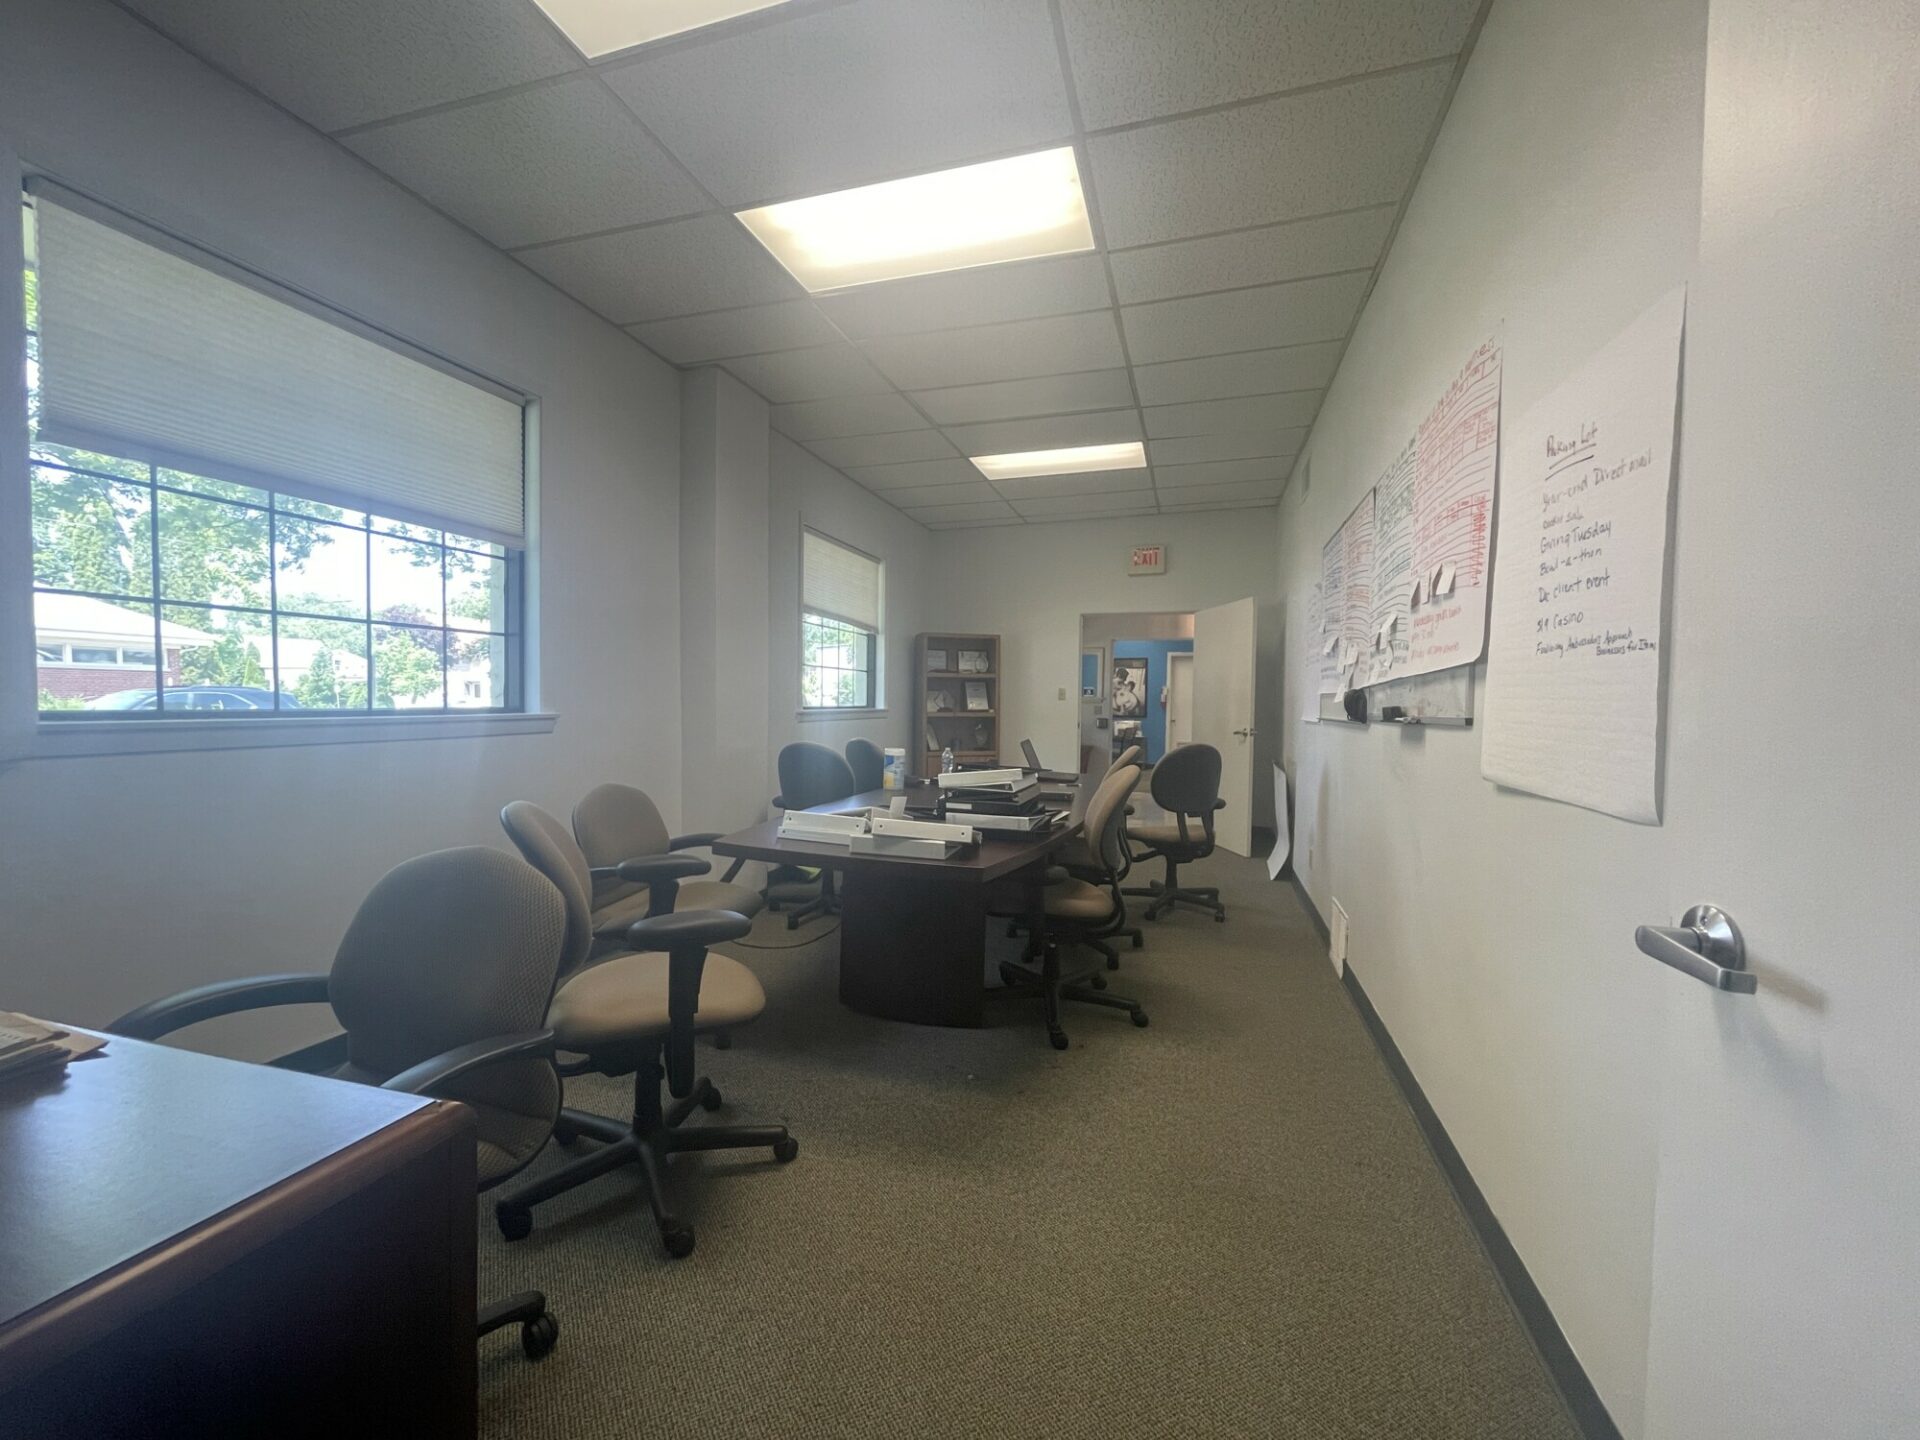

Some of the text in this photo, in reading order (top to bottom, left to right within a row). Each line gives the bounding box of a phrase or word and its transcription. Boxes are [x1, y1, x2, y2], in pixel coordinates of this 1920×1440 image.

[1581, 421, 1598, 444] Lot
[1571, 520, 1611, 542] Tuesday
[1133, 547, 1160, 567] EXIT
